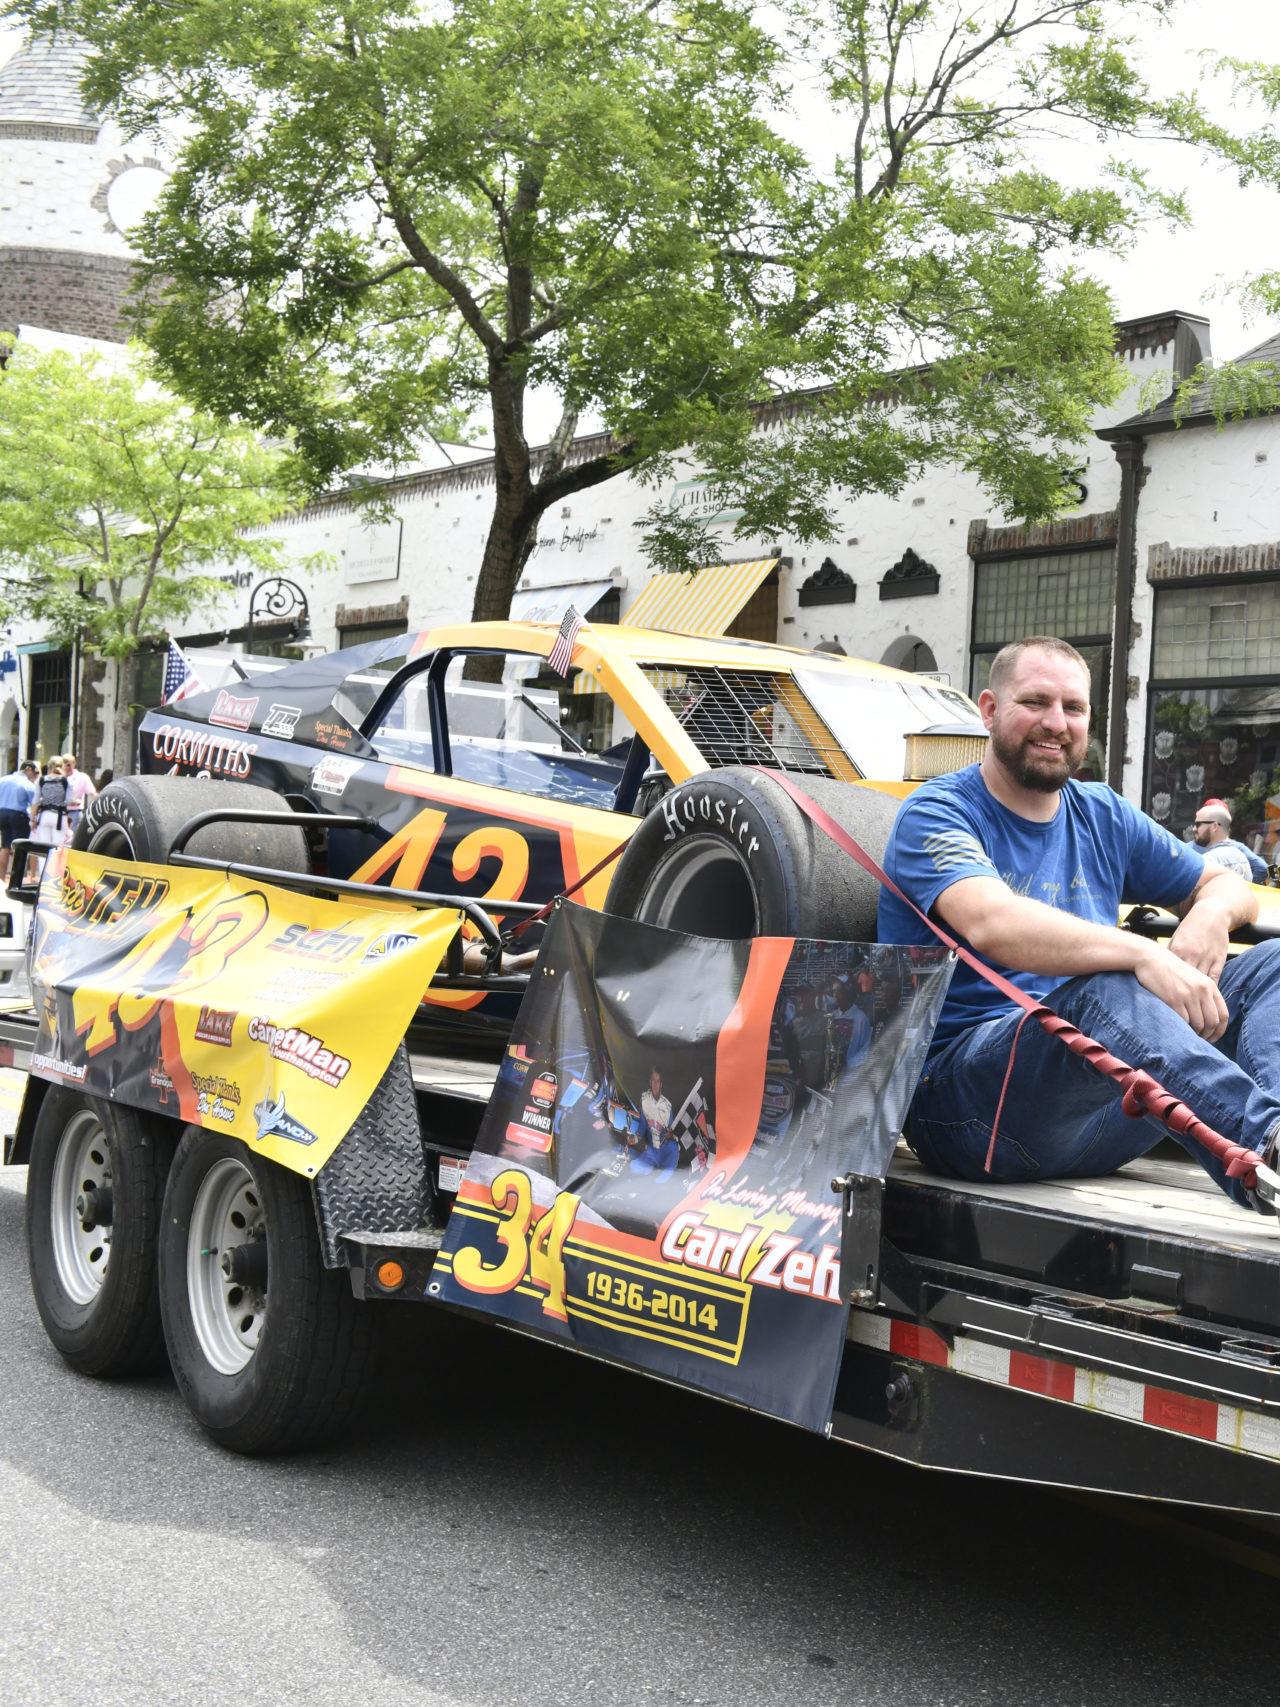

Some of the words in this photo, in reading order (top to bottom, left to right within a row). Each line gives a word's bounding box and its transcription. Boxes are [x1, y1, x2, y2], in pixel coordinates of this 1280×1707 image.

[152, 724, 256, 778] CORWITHS
[34, 1054, 88, 1080] opportunities!
[521, 1109, 553, 1131] WINNER
[722, 1174, 778, 1218] Loving
[453, 1168, 582, 1323] 34
[661, 1210, 762, 1276] Carl
[751, 1232, 843, 1304] Zeh
[586, 1271, 719, 1332] 1936-2014
